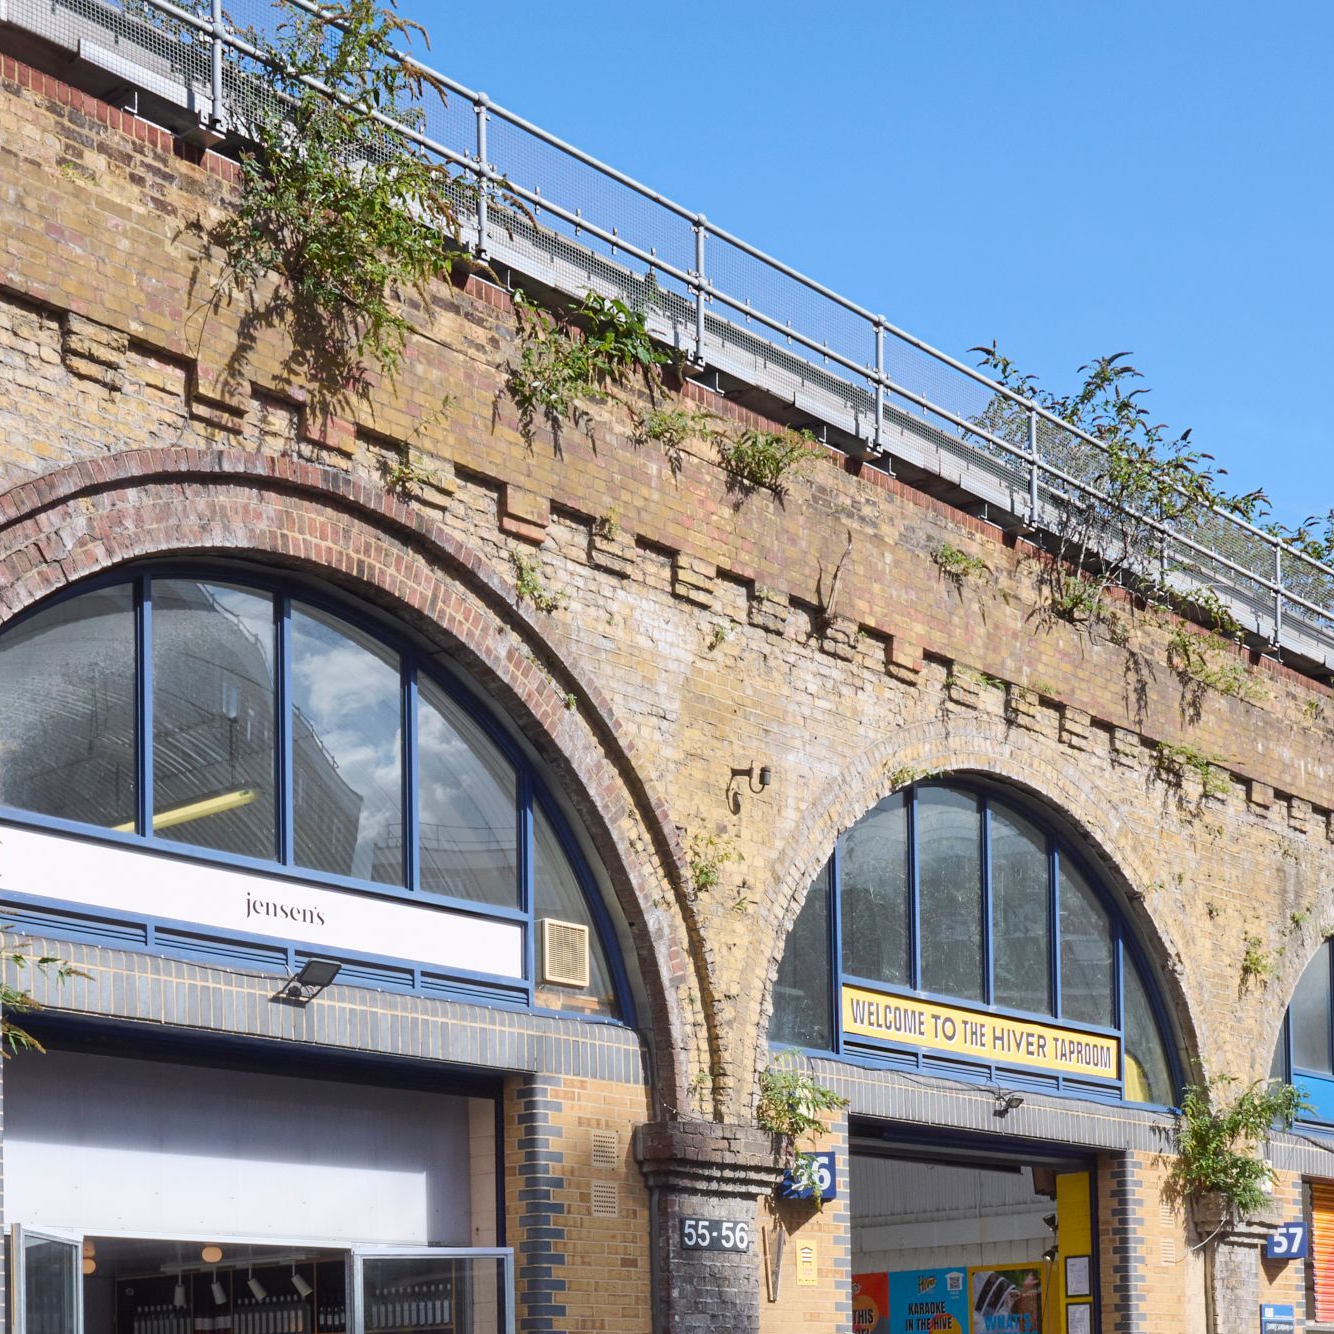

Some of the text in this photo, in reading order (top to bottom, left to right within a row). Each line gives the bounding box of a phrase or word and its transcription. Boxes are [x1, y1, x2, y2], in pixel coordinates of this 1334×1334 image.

[246, 891, 326, 926] jensen's
[851, 997, 1112, 1070] WELCOME TO THE HIVER TAPROOM
[683, 1220, 749, 1249] 55-56
[1273, 1227, 1303, 1253] 57
[908, 1301, 946, 1315] KARAOKE
[905, 1317, 952, 1331] IN THE HIVE
[984, 1313, 1031, 1331] WHAT'S
